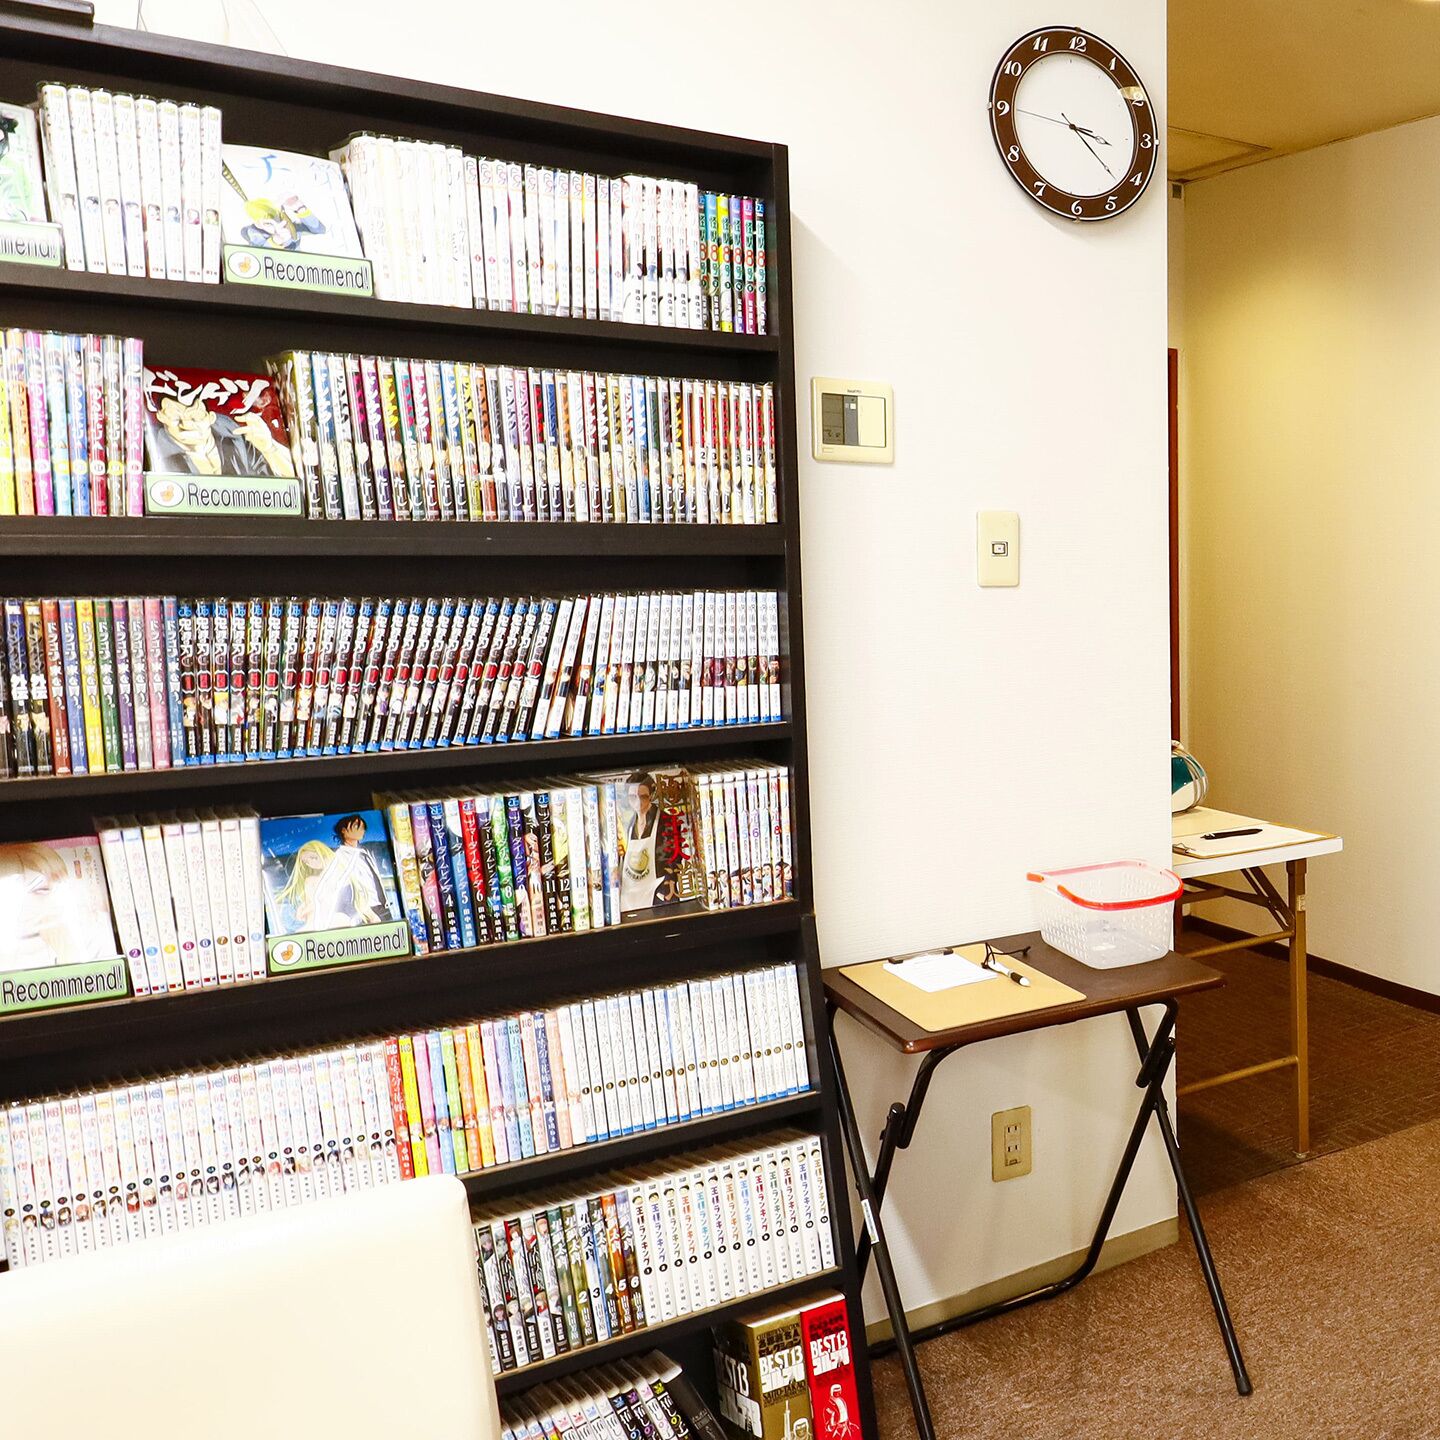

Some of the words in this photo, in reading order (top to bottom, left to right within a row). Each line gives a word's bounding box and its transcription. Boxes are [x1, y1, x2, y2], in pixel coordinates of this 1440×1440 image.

[1032, 36, 1049, 51] 11
[1069, 36, 1087, 52] 12
[1004, 60, 1022, 76] 10
[1108, 57, 1116, 71] 1
[996, 100, 1010, 116] 9
[1140, 133, 1152, 149] 3
[1007, 145, 1020, 162] 8
[1130, 172, 1143, 186] 4
[1033, 181, 1047, 197] 7
[1071, 200, 1083, 215] 6
[1105, 196, 1118, 210] 5
[264, 256, 370, 291] Recommend!
[188, 482, 298, 510] Recommend!
[545, 880, 556, 893] 11
[560, 878, 571, 891] 12
[461, 892, 468, 904] 5
[476, 889, 484, 902] 6
[505, 886, 512, 899] 8
[445, 895, 454, 907] 4
[305, 927, 407, 963] Recommend!
[1, 963, 124, 1005] Recommend!
[618, 1278, 627, 1291] 5
[631, 1275, 640, 1288] 6
[578, 1290, 589, 1304] 2
[592, 1287, 601, 1298] 3
